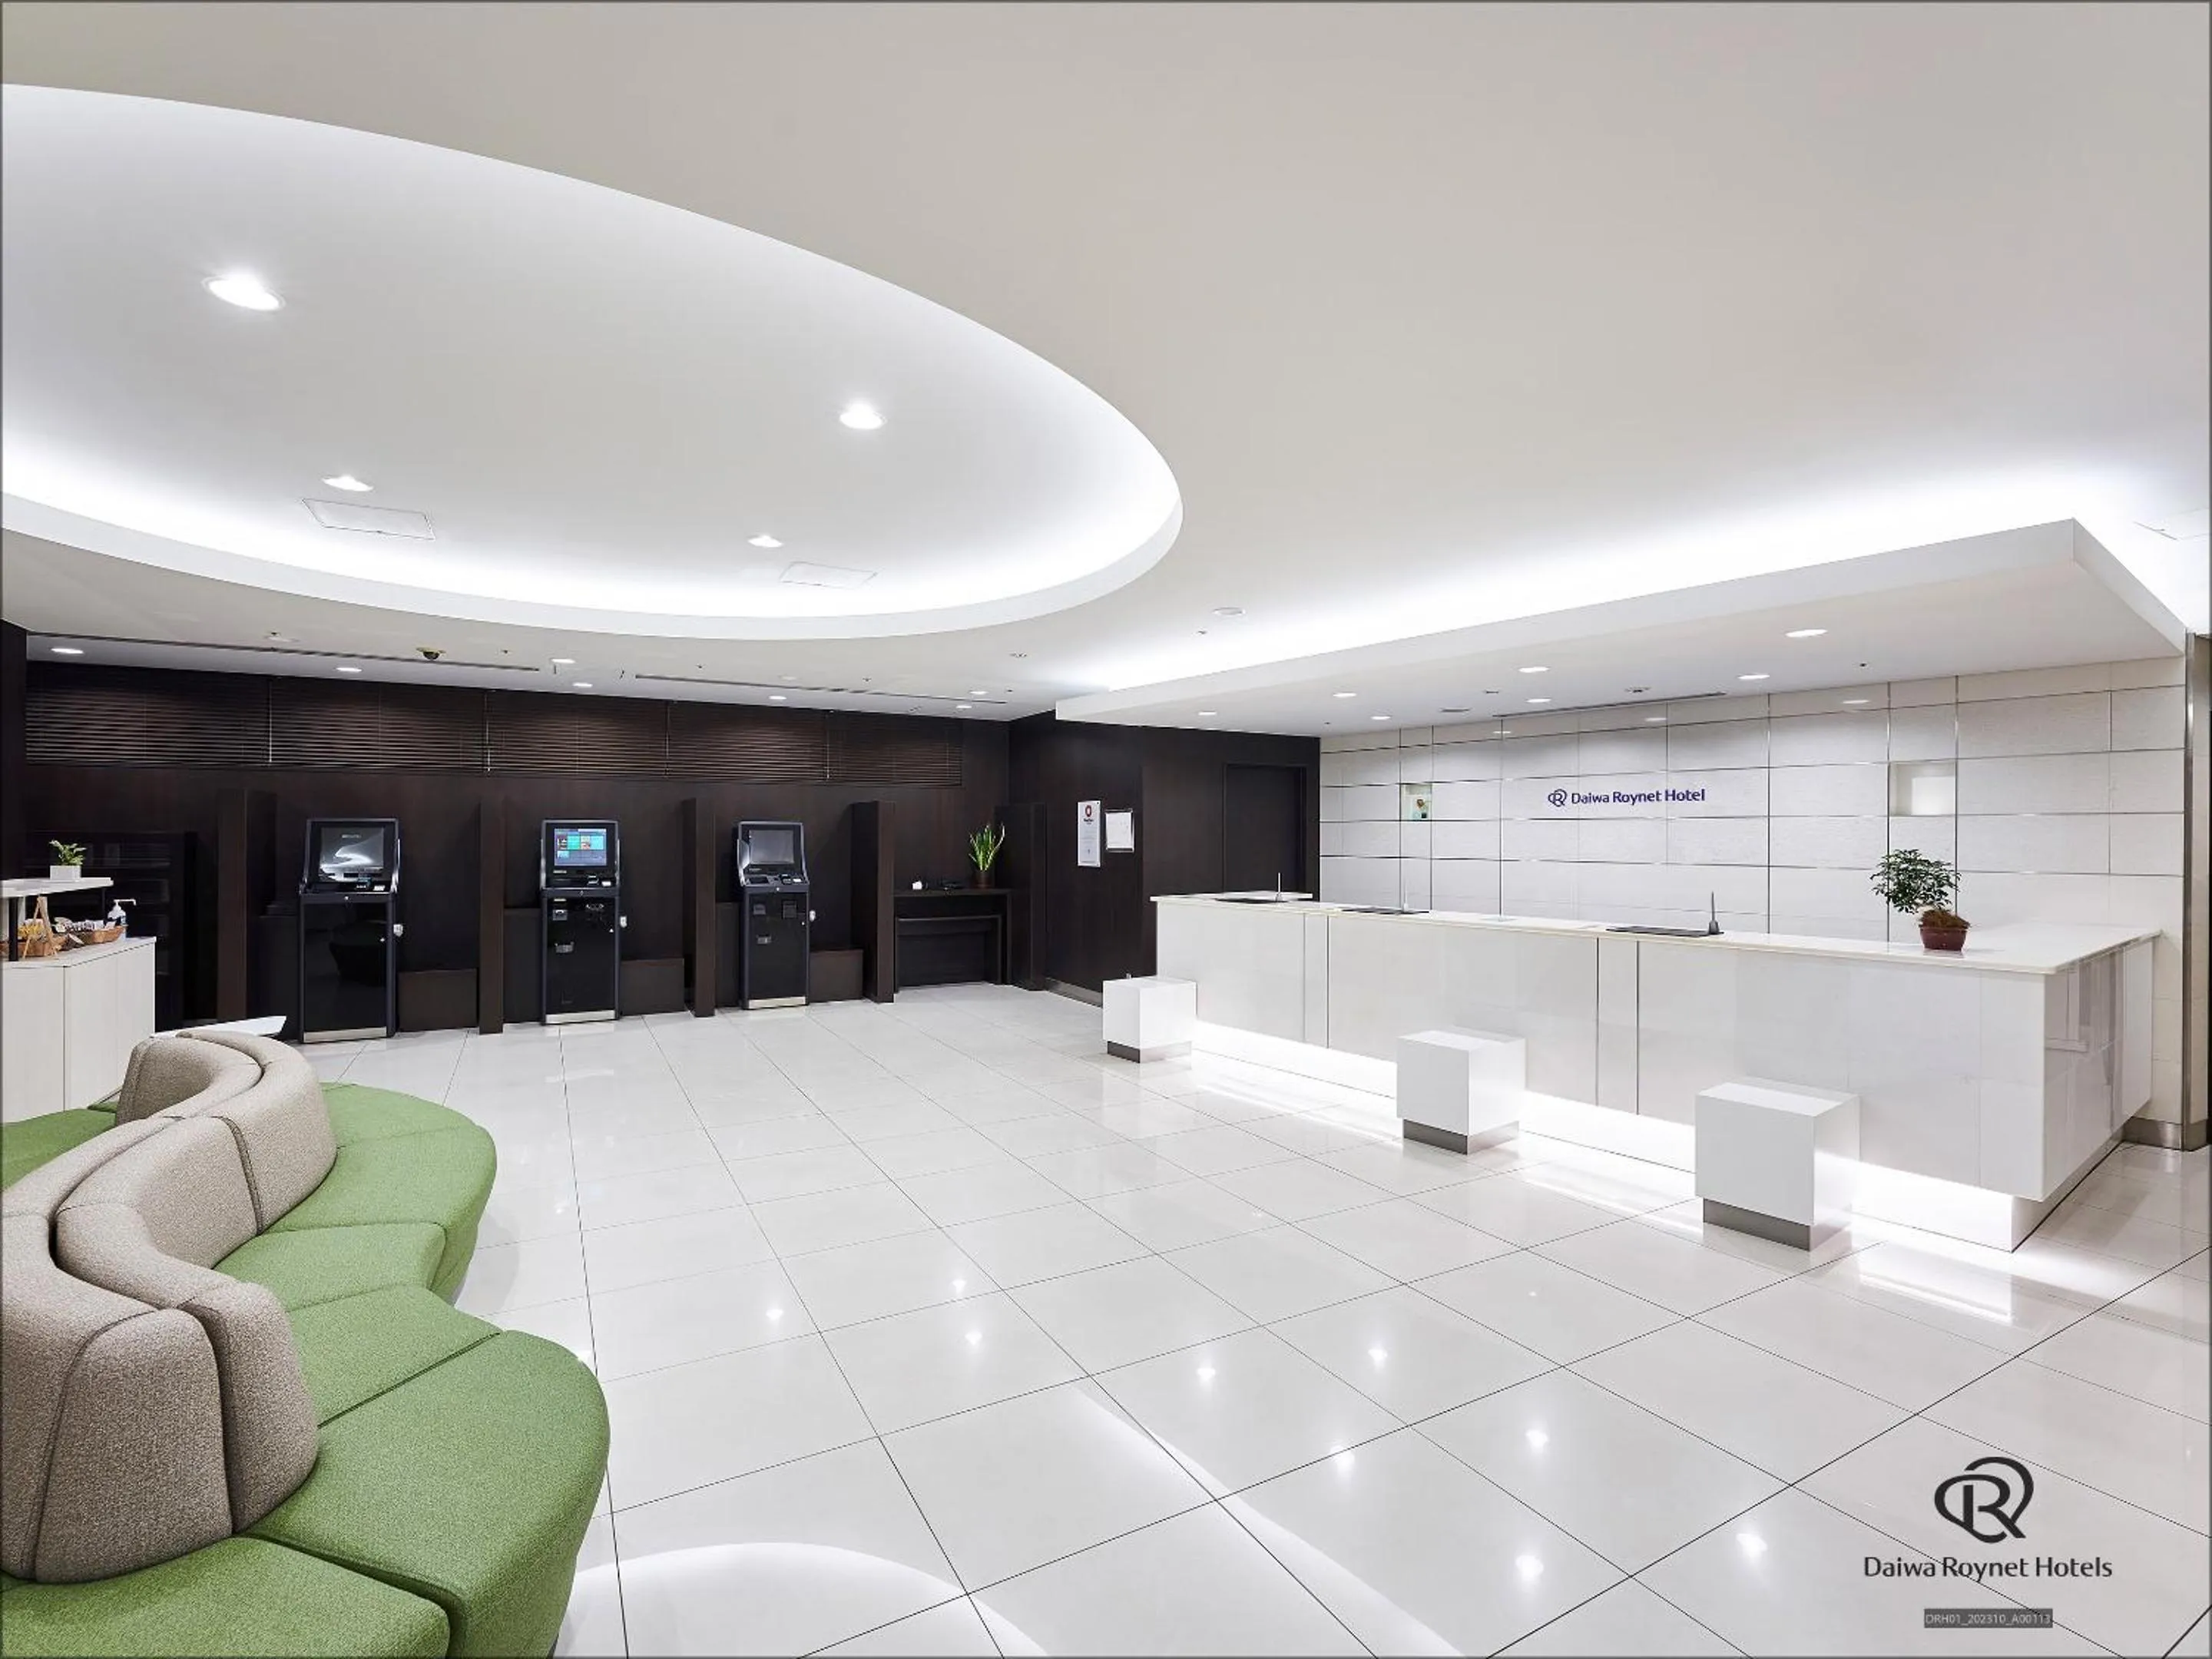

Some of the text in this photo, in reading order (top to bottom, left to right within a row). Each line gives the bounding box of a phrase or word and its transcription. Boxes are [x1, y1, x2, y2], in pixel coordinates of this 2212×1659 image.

[1571, 792, 1610, 804] Daiwa
[1612, 790, 1662, 806] Roynet
[1664, 788, 1706, 802] Hotel
